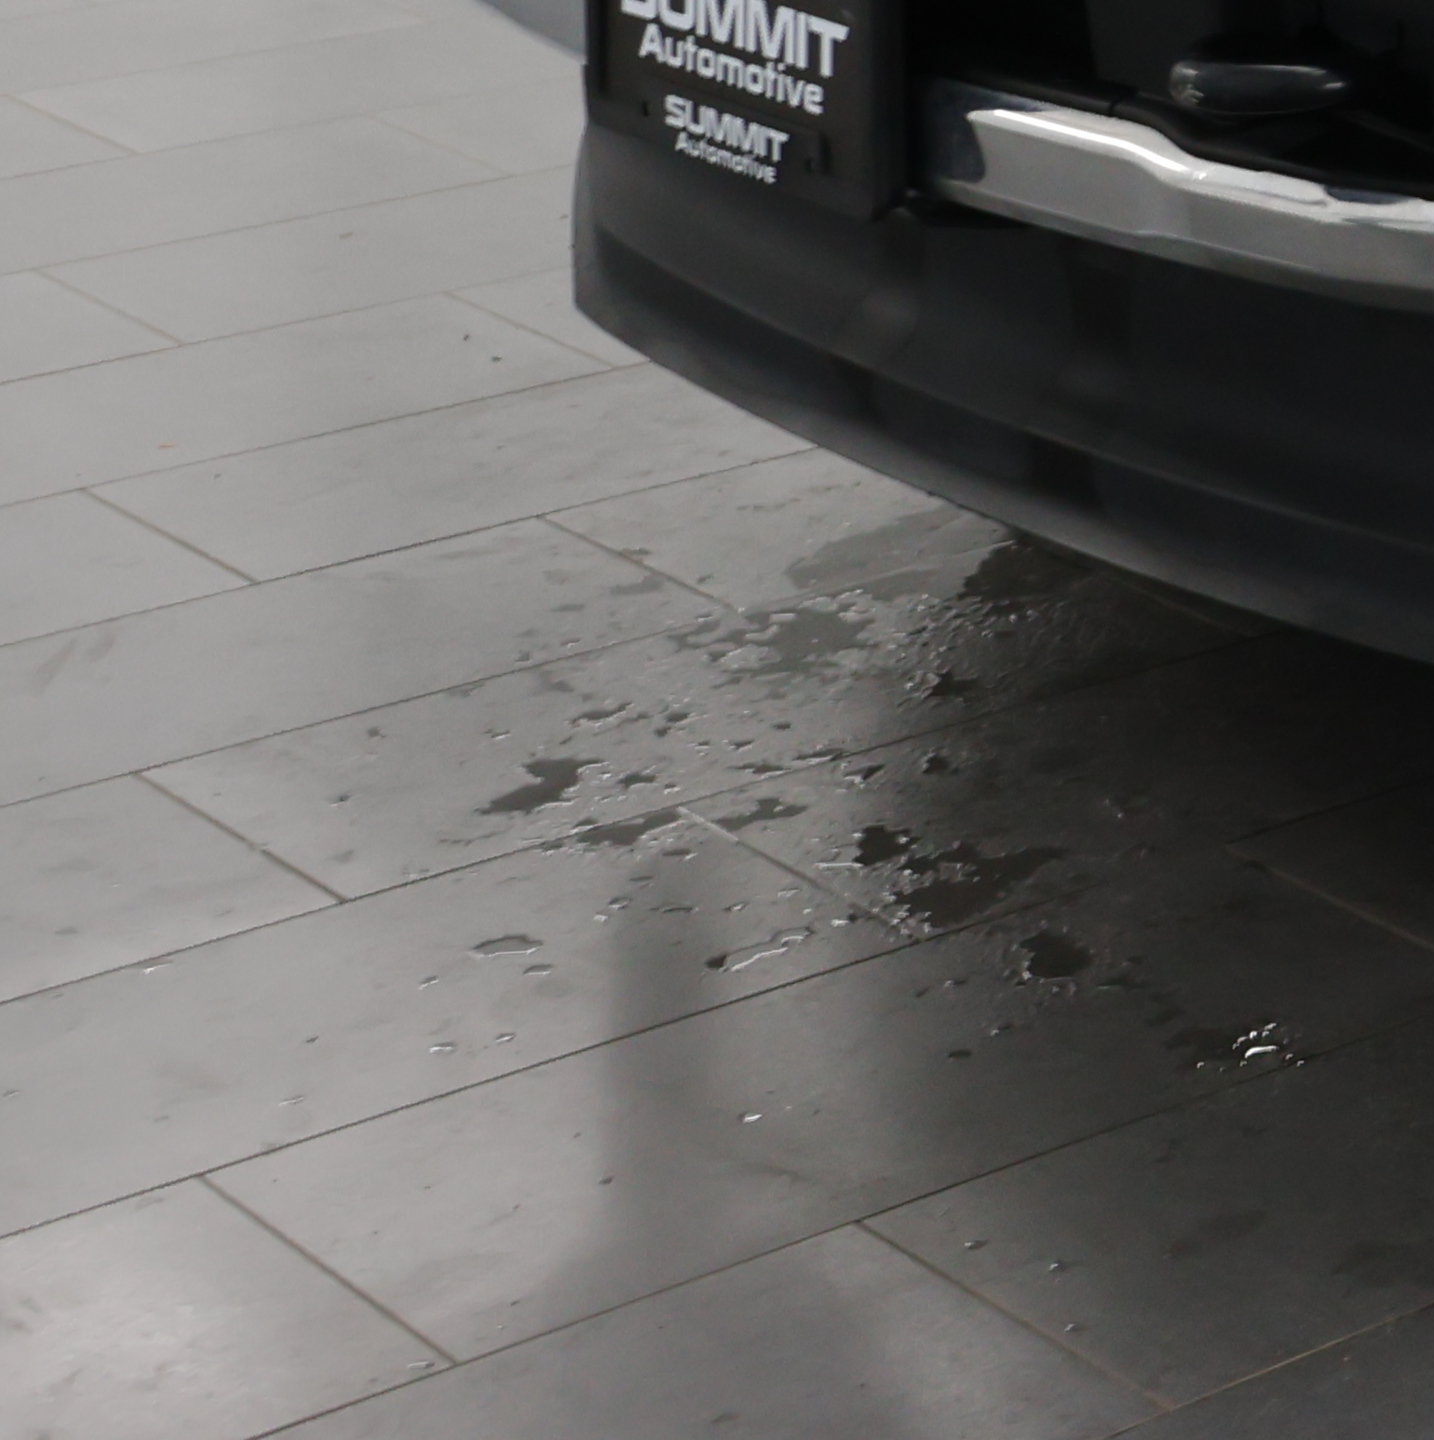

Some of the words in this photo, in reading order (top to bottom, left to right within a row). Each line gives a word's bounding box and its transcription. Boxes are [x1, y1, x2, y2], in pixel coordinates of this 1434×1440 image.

[638, 22, 825, 116] Automotive
[664, 94, 791, 163] SUMMIT
[674, 130, 778, 185] Automotive
